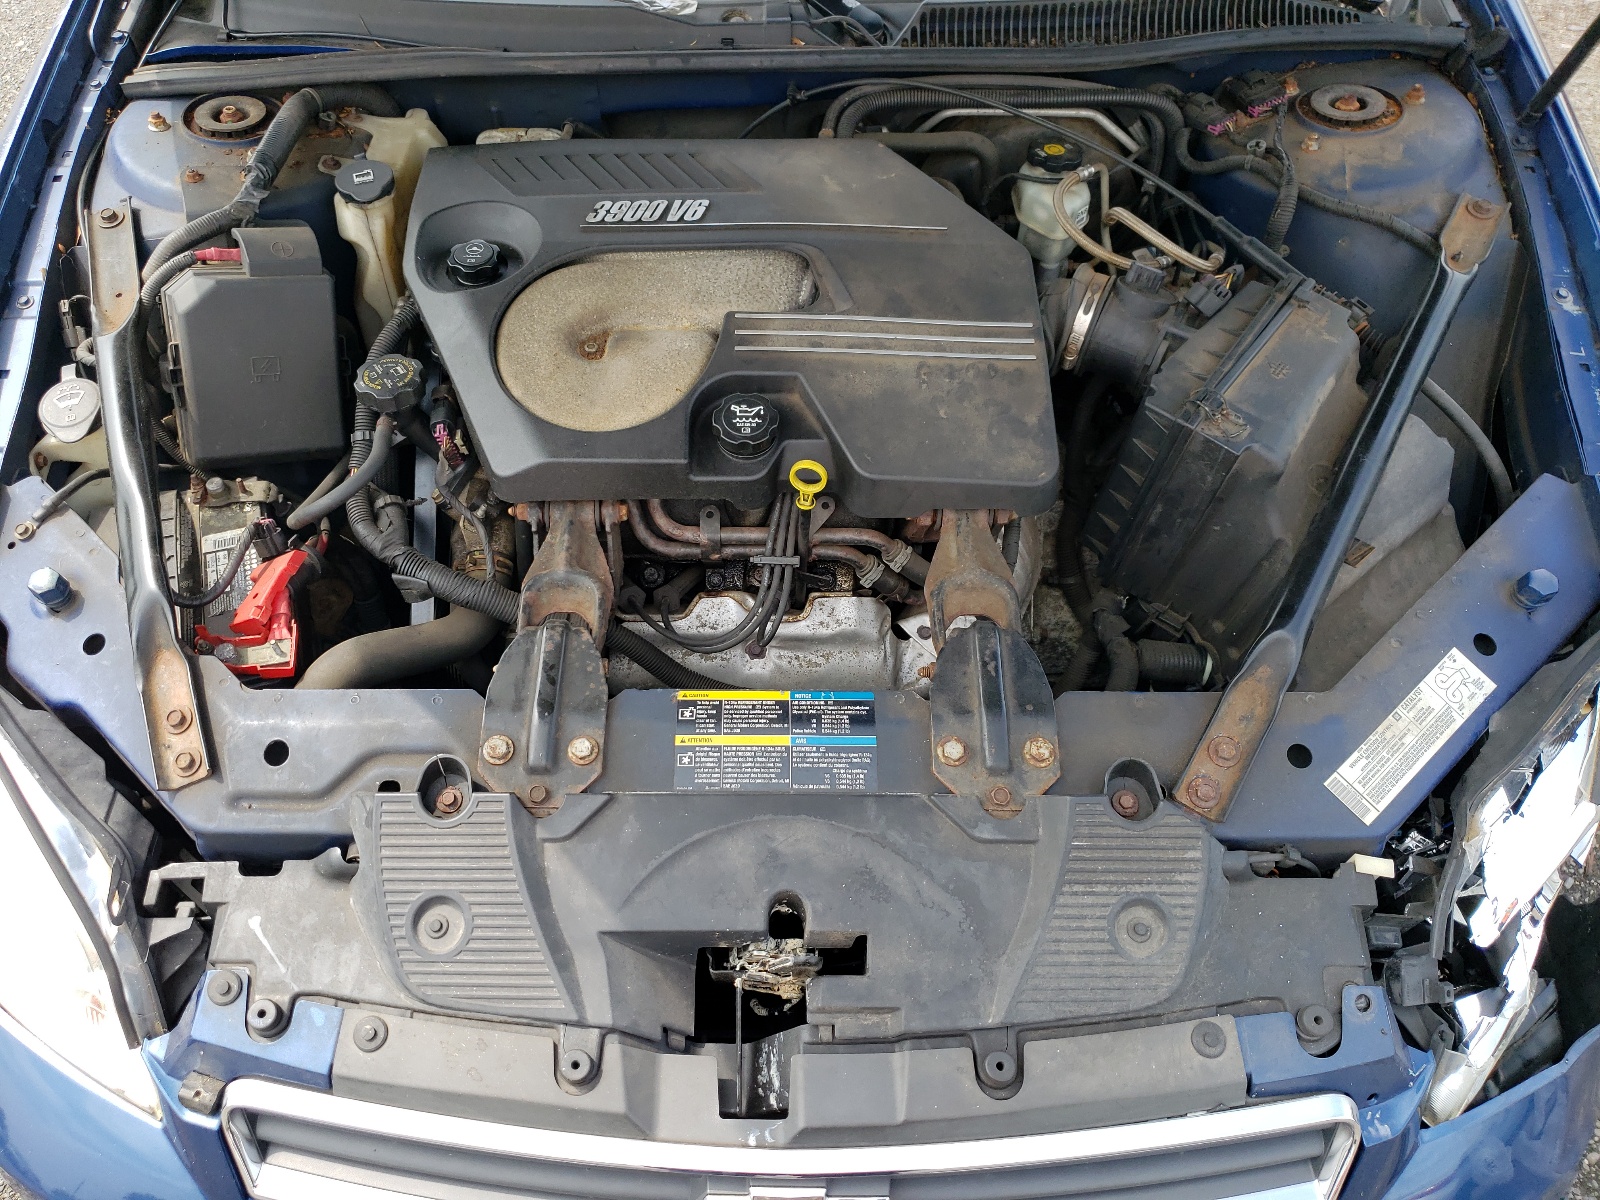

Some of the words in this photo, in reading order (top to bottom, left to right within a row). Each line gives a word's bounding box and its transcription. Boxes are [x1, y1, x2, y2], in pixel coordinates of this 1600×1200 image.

[586, 200, 668, 222] 3900
[667, 200, 710, 222] V6
[1400, 686, 1424, 711] CATALYST
